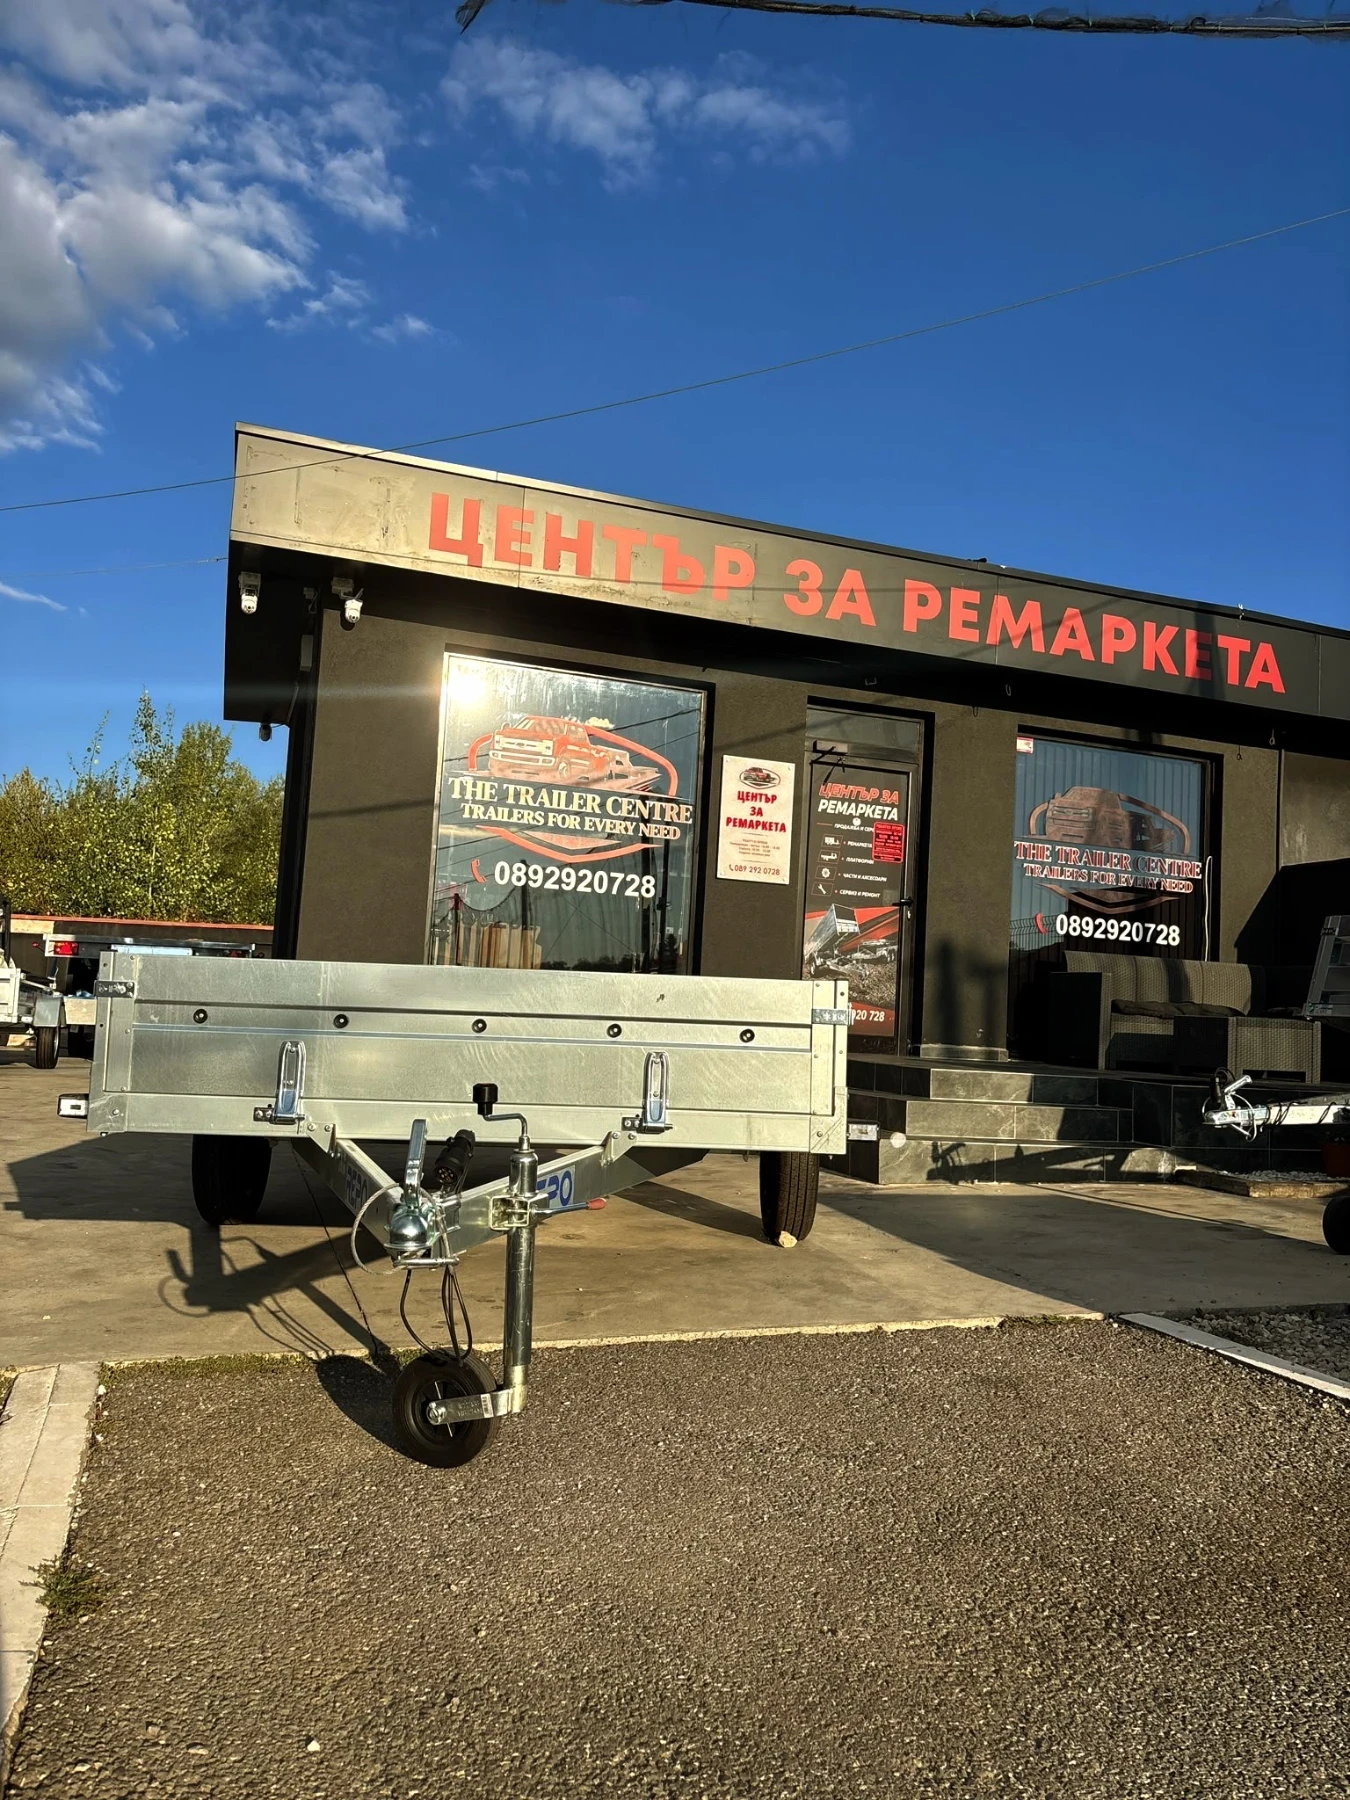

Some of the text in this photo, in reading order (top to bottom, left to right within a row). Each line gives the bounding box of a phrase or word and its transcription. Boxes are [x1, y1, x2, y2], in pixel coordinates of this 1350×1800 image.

[429, 492, 1286, 694] ЦЕНТЪР ЗА РЕМАРКЕТА
[448, 776, 693, 824] THE TRAILER CENTRE
[737, 791, 777, 804] ЦЕНТЪР
[819, 783, 899, 805] ЦЕНТЪР ЗА
[460, 803, 681, 840] TRAILERS FOR EVERY NEED
[750, 806, 763, 817] ЗА
[818, 799, 898, 821] РЕМАРКЕТА
[726, 817, 786, 833] РЕМАРКЕТА
[749, 866, 761, 874] 292
[1014, 841, 1202, 879] THE TRAILER CENTRE
[494, 861, 656, 898] 0892920728
[1023, 863, 1194, 894] TRAILERS FOR EVERY NEED
[1056, 914, 1180, 946] 0892920728
[869, 1010, 885, 1022] 728
